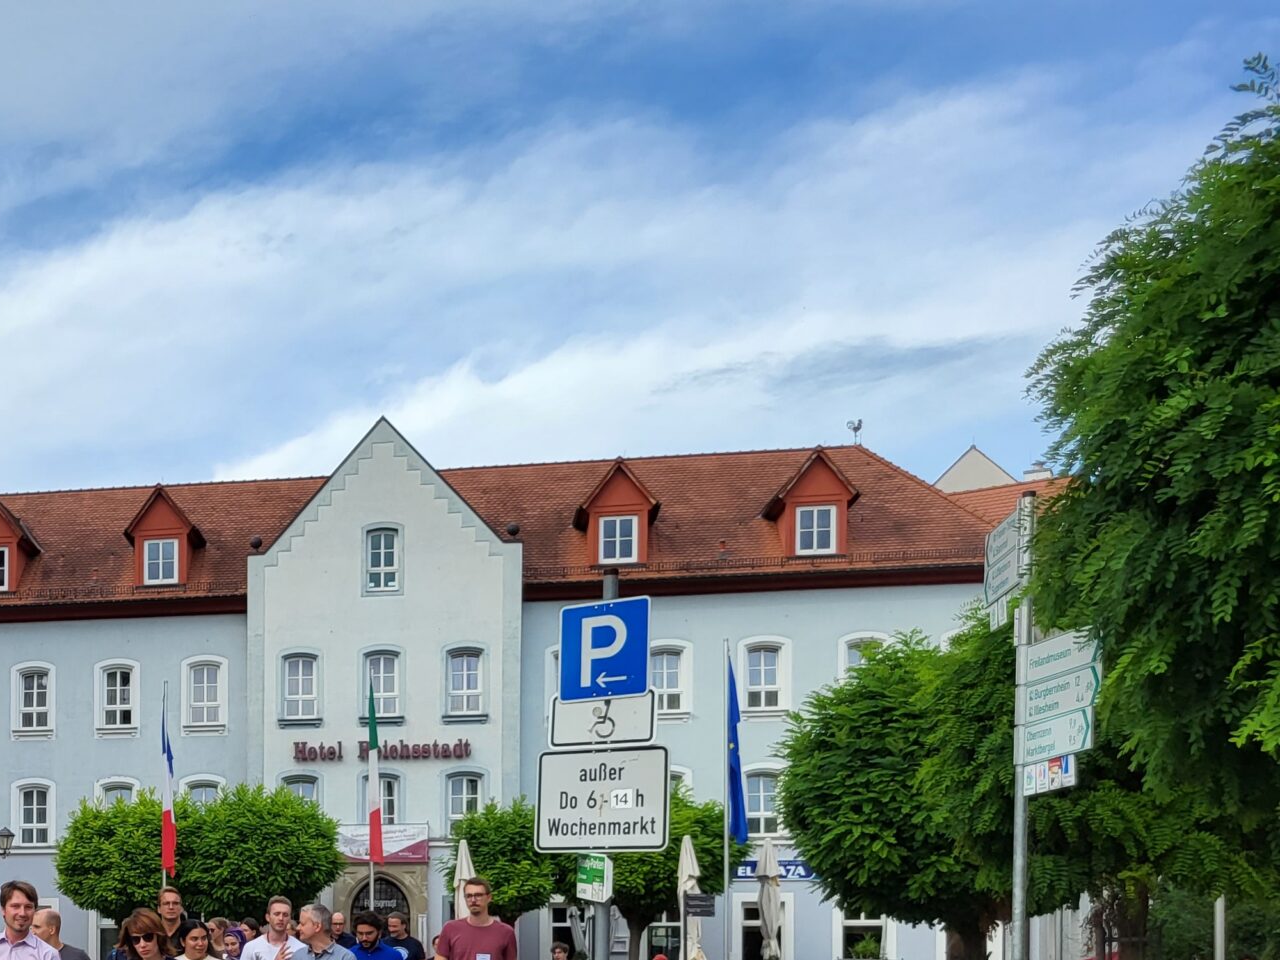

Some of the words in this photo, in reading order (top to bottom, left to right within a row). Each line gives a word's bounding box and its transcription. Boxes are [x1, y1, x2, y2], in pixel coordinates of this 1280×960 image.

[581, 615, 627, 688] P
[1029, 648, 1072, 671] Freilandmuseum
[293, 741, 343, 761] Hotel
[580, 763, 625, 782] außer
[560, 790, 578, 810] Do
[548, 816, 656, 837] Wochenmarkt
[737, 866, 753, 877] EL
